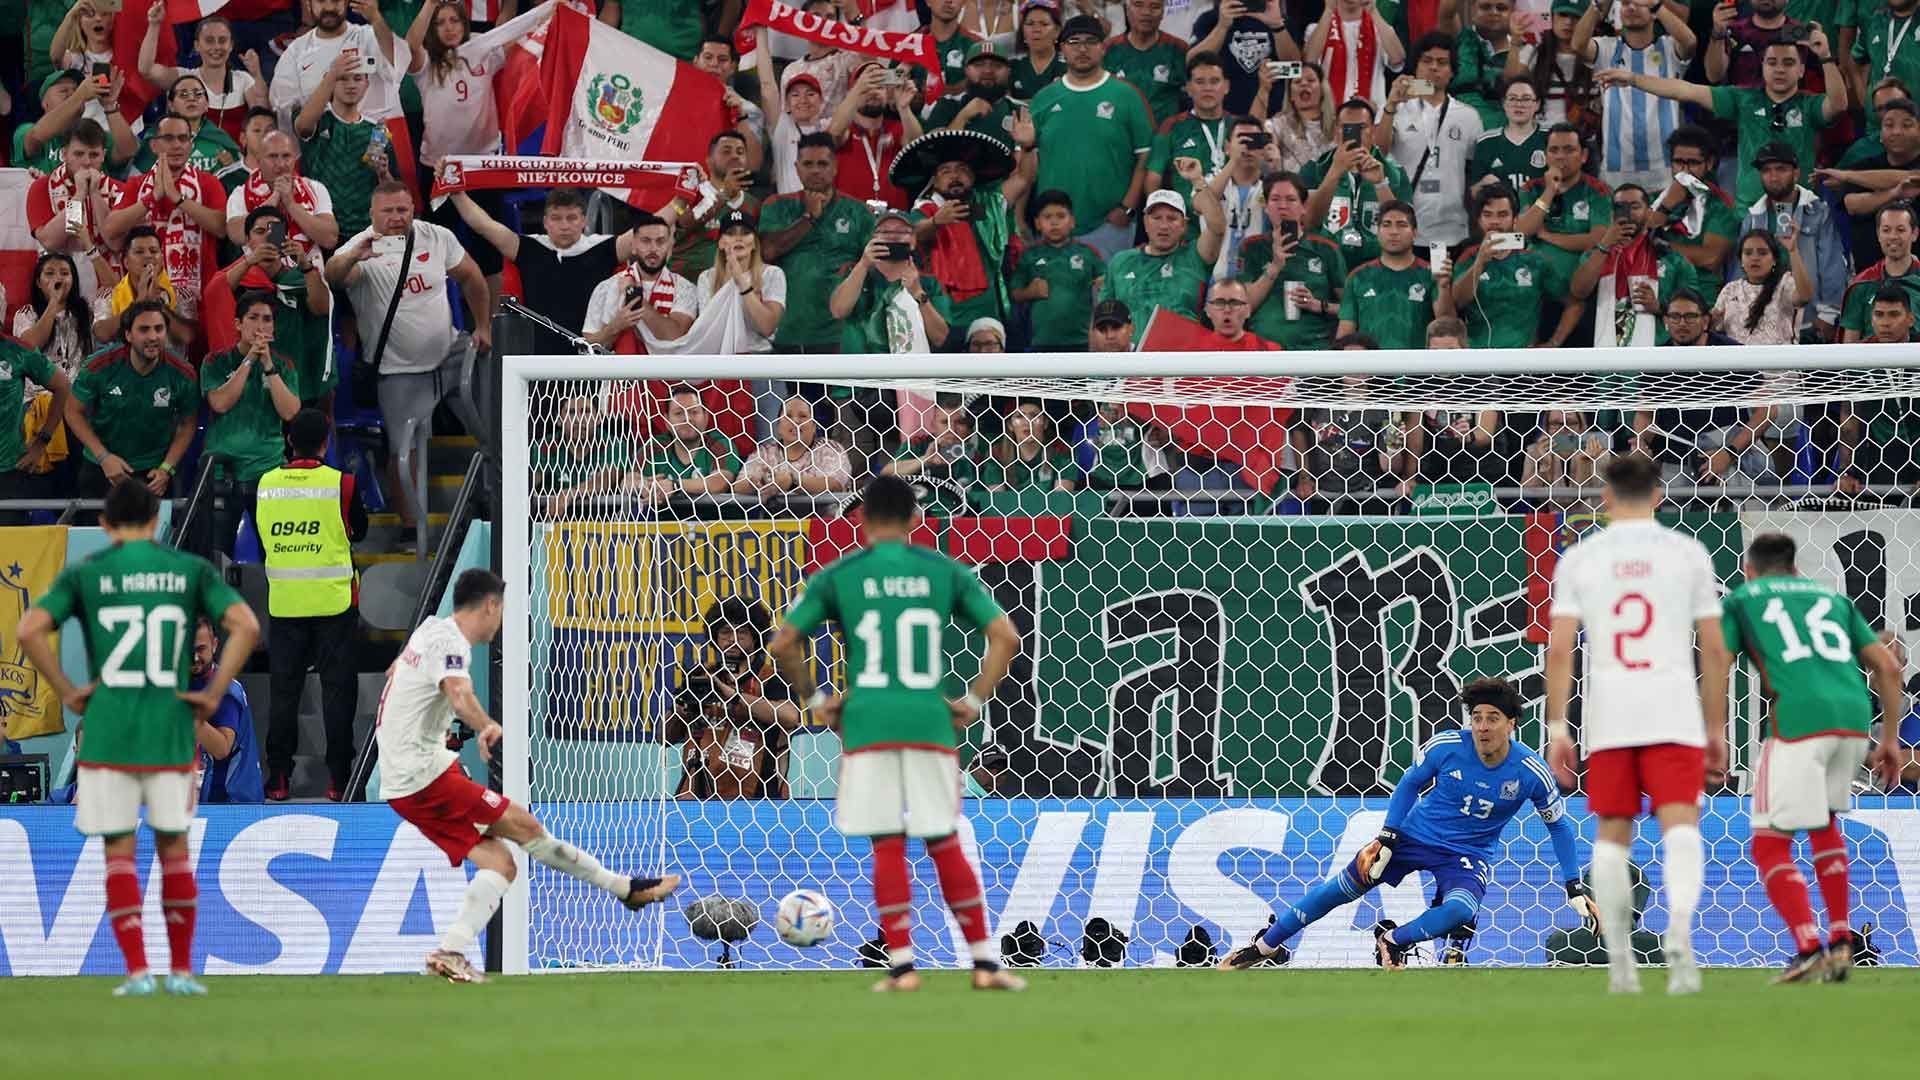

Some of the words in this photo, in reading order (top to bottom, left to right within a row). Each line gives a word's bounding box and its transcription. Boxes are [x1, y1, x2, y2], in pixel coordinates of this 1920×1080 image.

[768, 0, 924, 57] POLSKA
[455, 79, 468, 102] 9
[480, 160, 589, 170] KIBICUJEMY
[516, 172, 625, 184] NIETKOWICE
[270, 520, 321, 537] 0948
[272, 542, 324, 554] Security
[1612, 591, 1654, 671] 2
[1761, 596, 1852, 663] 16
[97, 604, 188, 689] 20
[854, 608, 944, 690] 10
[1459, 794, 1495, 819] 13
